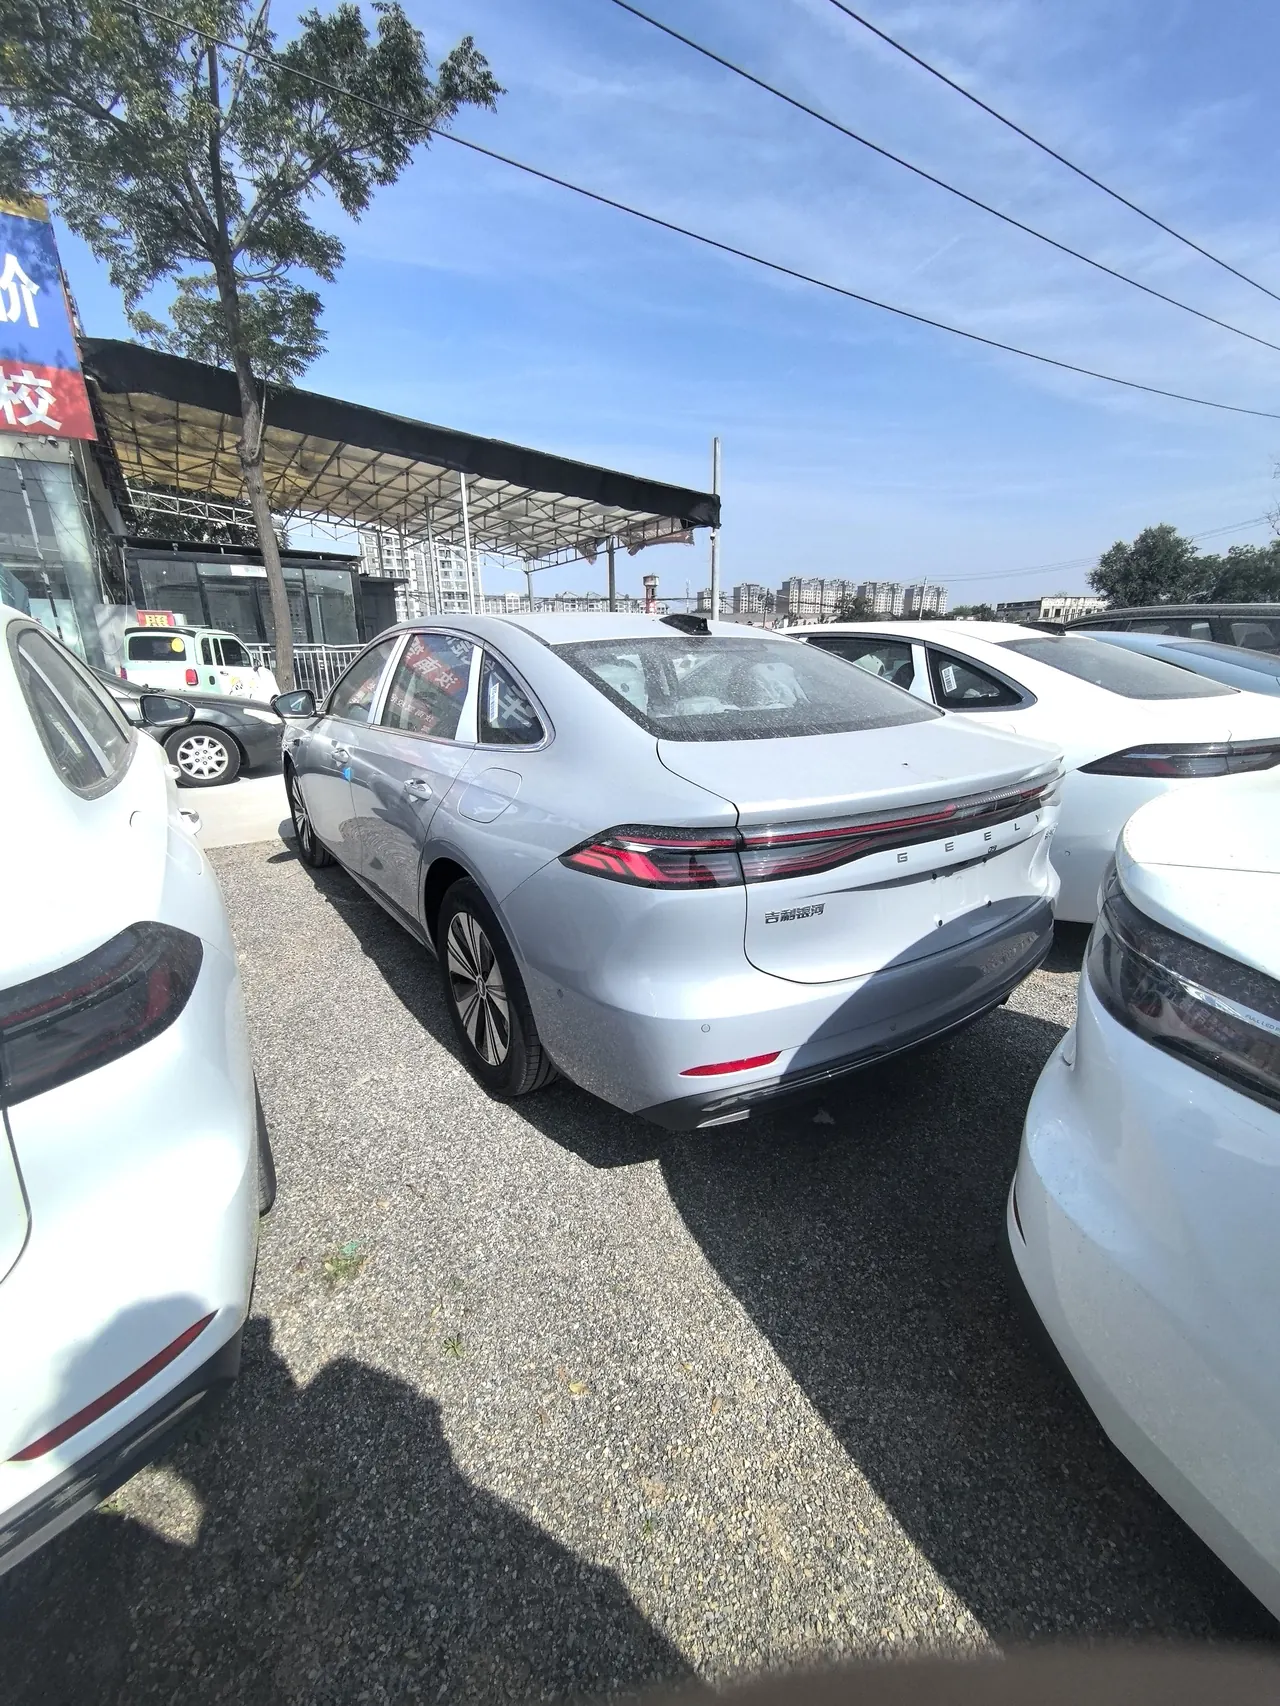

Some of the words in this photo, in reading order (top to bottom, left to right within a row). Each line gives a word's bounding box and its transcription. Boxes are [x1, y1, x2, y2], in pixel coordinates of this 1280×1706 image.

[0, 253, 40, 329] 价
[0, 366, 63, 431] 校
[765, 902, 826, 924] 吉利银河
